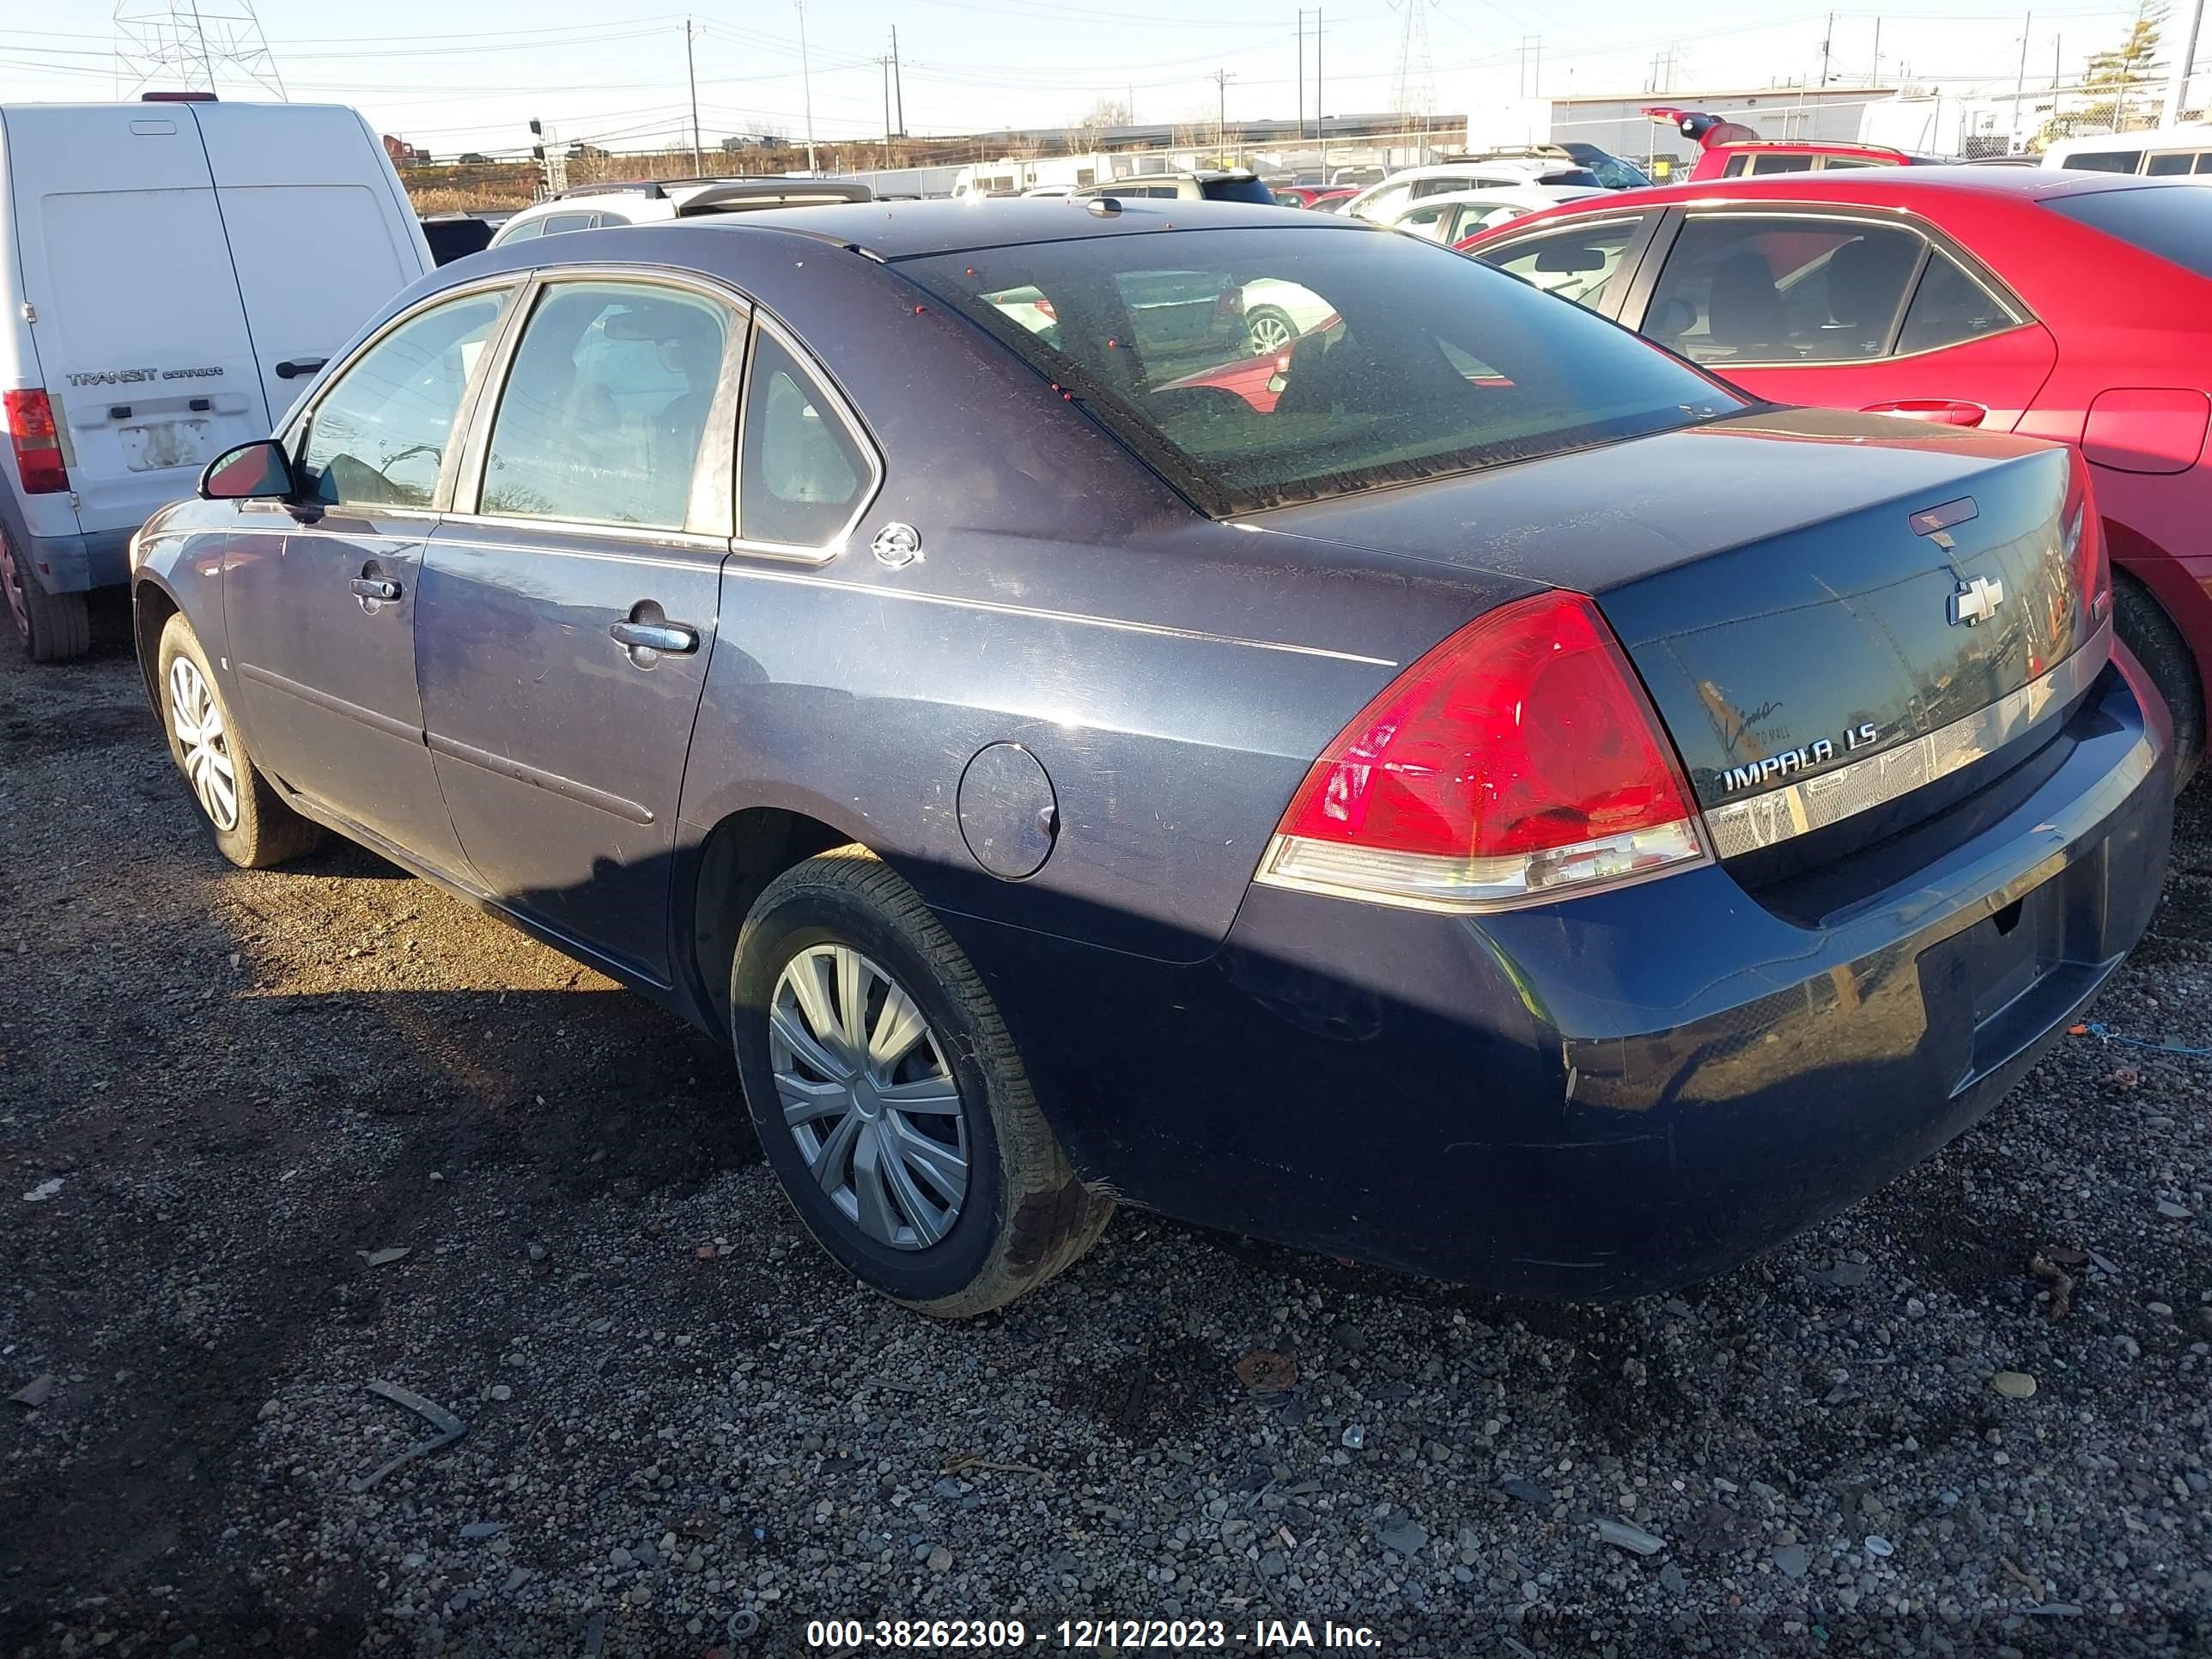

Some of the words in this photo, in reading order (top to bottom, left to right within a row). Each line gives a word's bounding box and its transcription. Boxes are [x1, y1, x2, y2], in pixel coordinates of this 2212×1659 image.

[66, 368, 158, 386] TRANSIT
[162, 366, 223, 380] connect
[1723, 738, 1834, 792] IMPALA
[1844, 721, 1877, 751] LS
